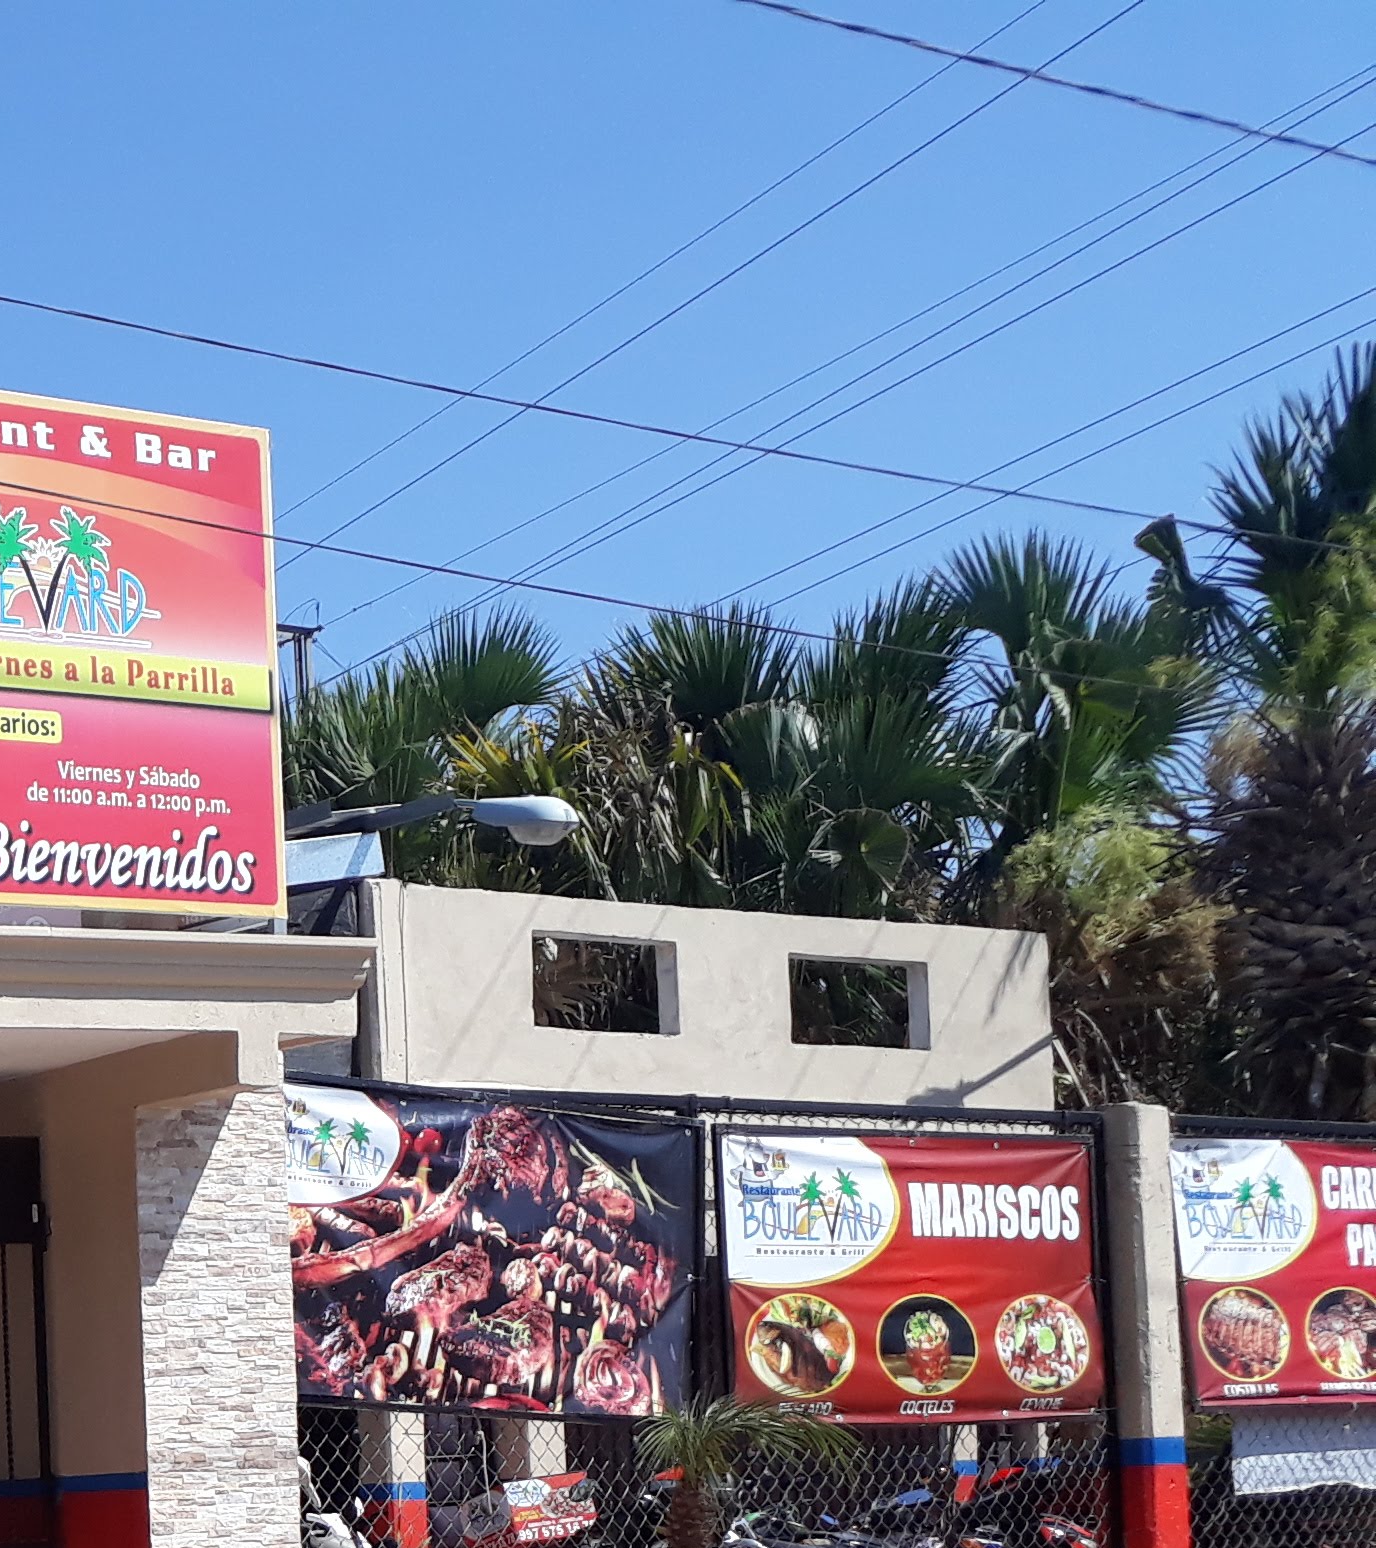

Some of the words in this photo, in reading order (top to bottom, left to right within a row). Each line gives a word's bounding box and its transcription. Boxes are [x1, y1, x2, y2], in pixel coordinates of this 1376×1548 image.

[79, 424, 112, 458] &
[134, 431, 217, 473] Bar
[64, 662, 80, 682] a
[90, 656, 116, 685] la
[127, 659, 235, 697] Parrilla
[57, 759, 122, 783] Viernes
[126, 768, 136, 790] y
[139, 765, 201, 790] Sábado
[26, 781, 48, 802] de
[53, 786, 93, 805] 11:00
[96, 790, 133, 808] a.m.
[137, 793, 147, 809] a
[150, 792, 191, 812] 12:00
[195, 797, 231, 817] p.m.
[742, 1183, 801, 1197] Restaurante
[743, 1199, 882, 1243] BOULEVARD
[907, 1180, 1080, 1241] MARISCOS
[899, 1400, 954, 1415] COCTELES
